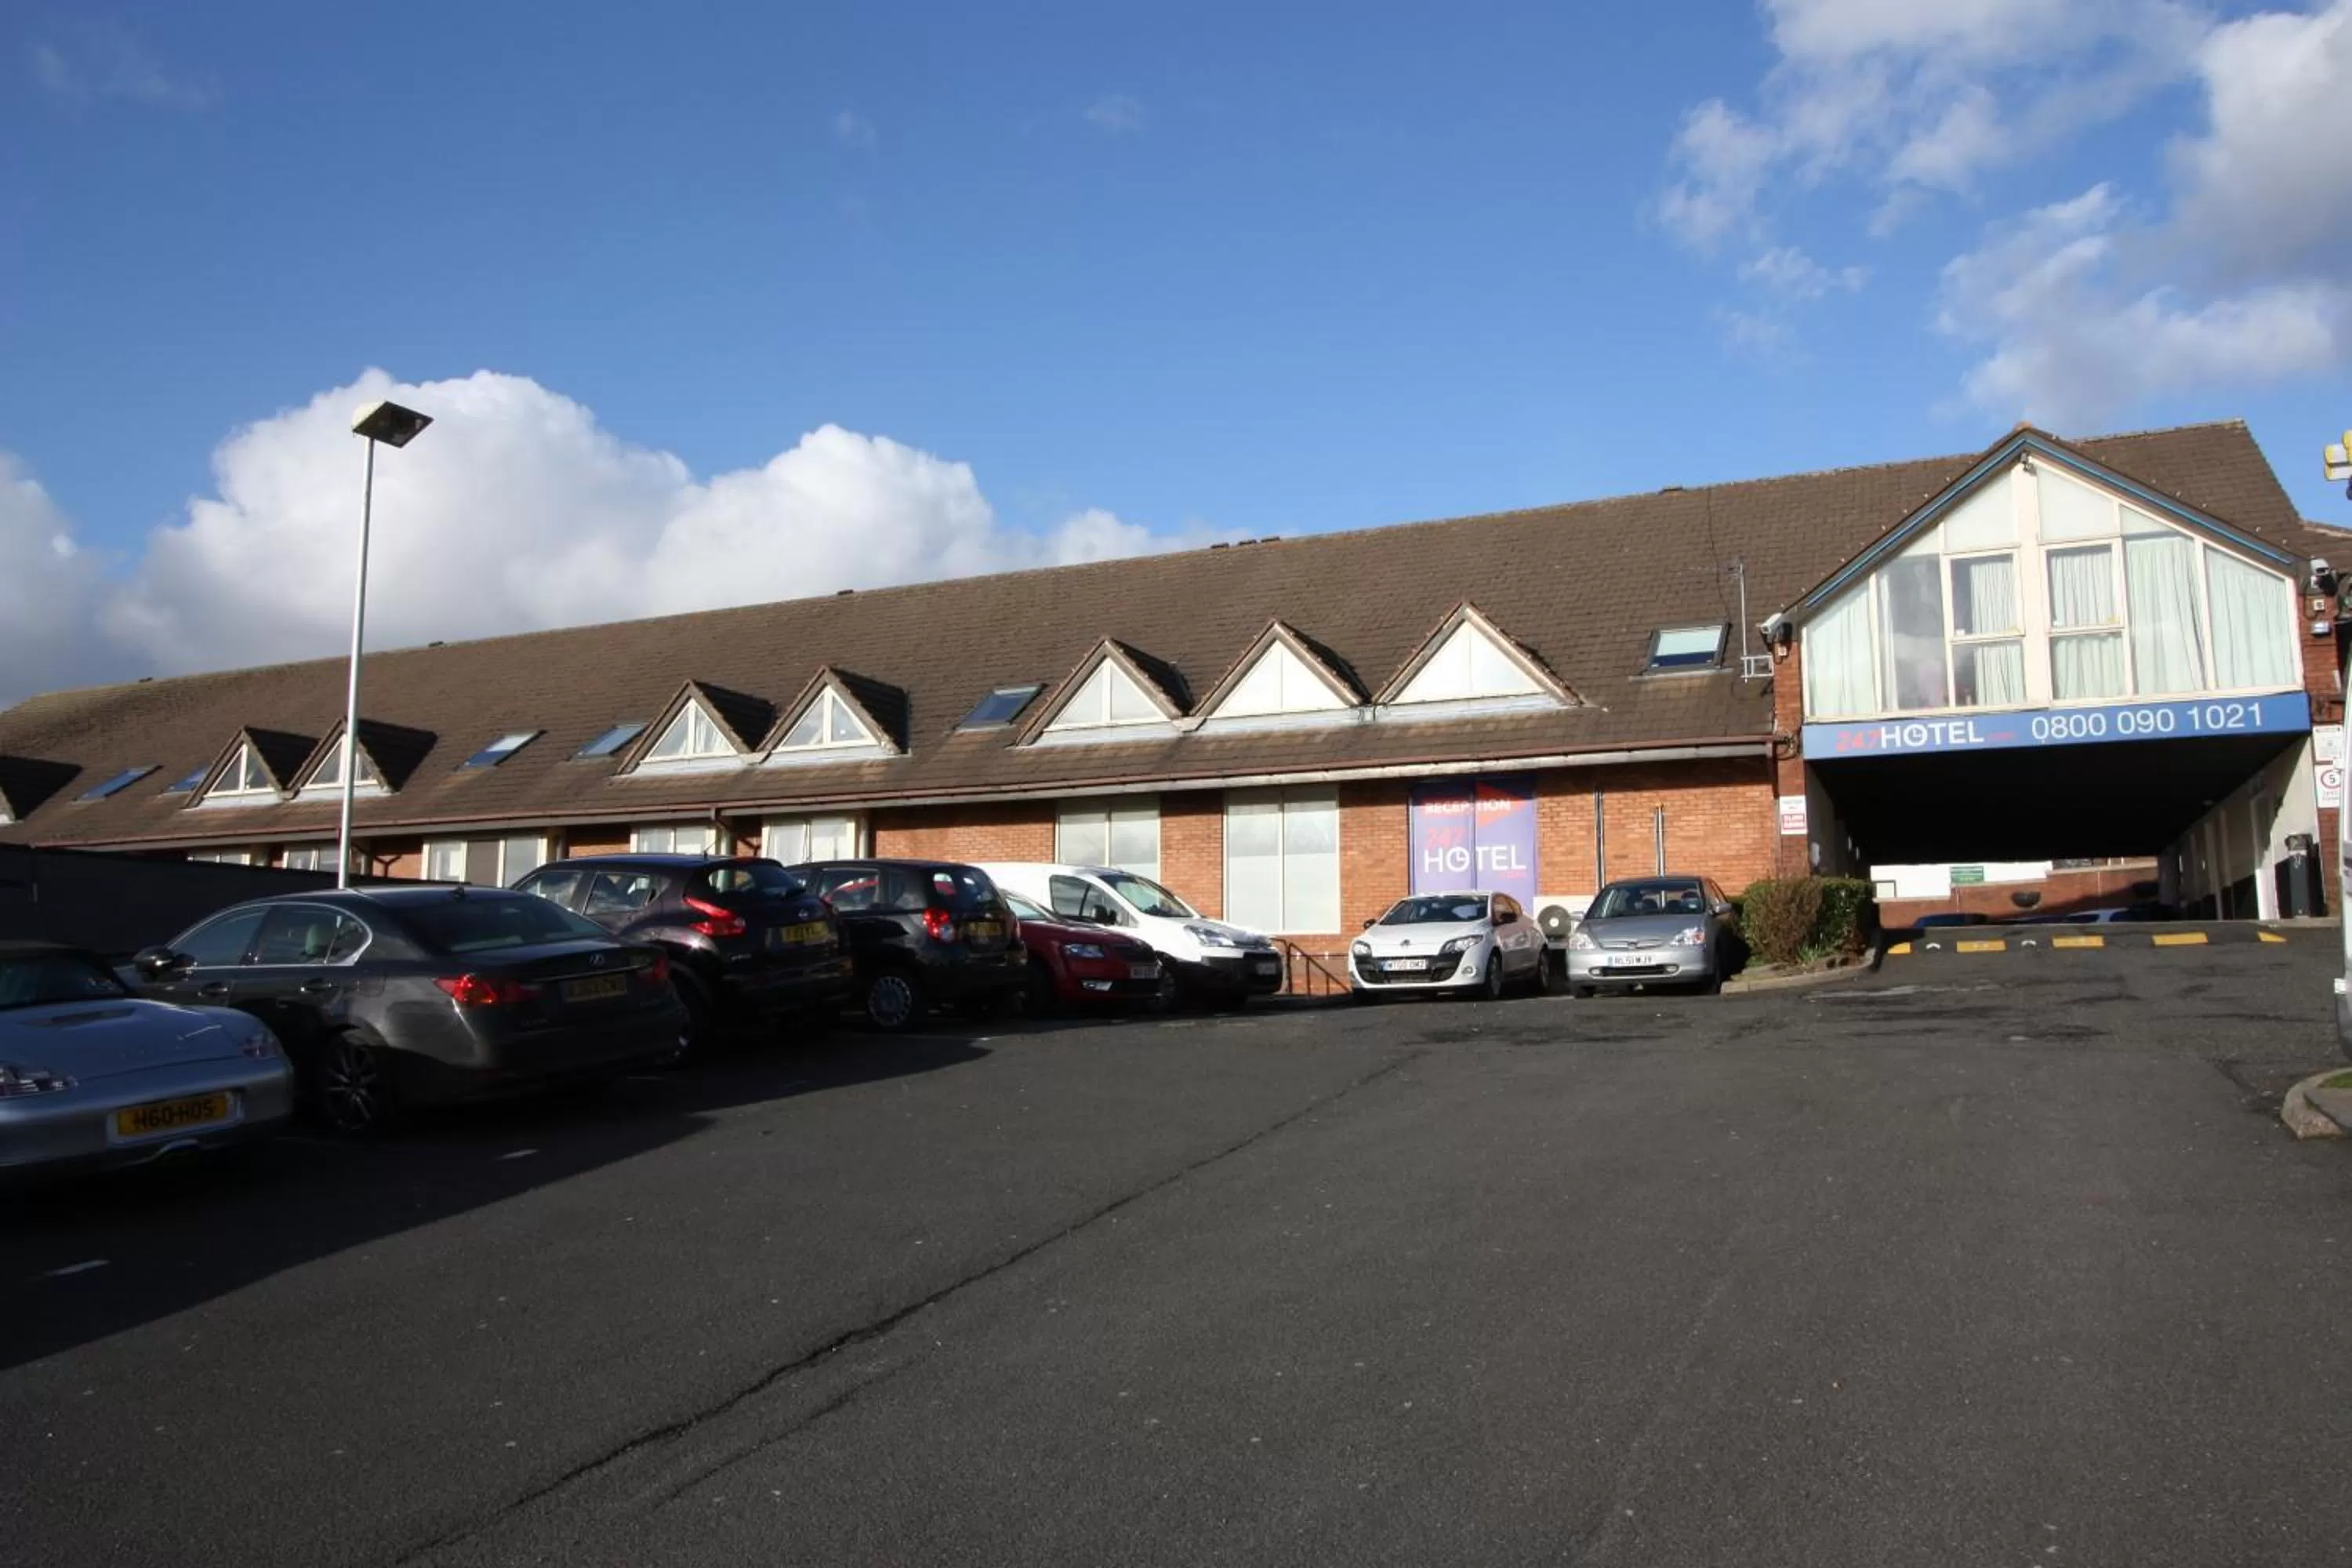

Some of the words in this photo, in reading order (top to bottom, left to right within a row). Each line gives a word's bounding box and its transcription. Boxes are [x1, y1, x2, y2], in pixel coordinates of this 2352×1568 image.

[2031, 712, 2107, 740] 0800
[2117, 709, 2175, 735] 090
[2186, 702, 2263, 730] 1021
[1424, 844, 1527, 873] HOTEL
